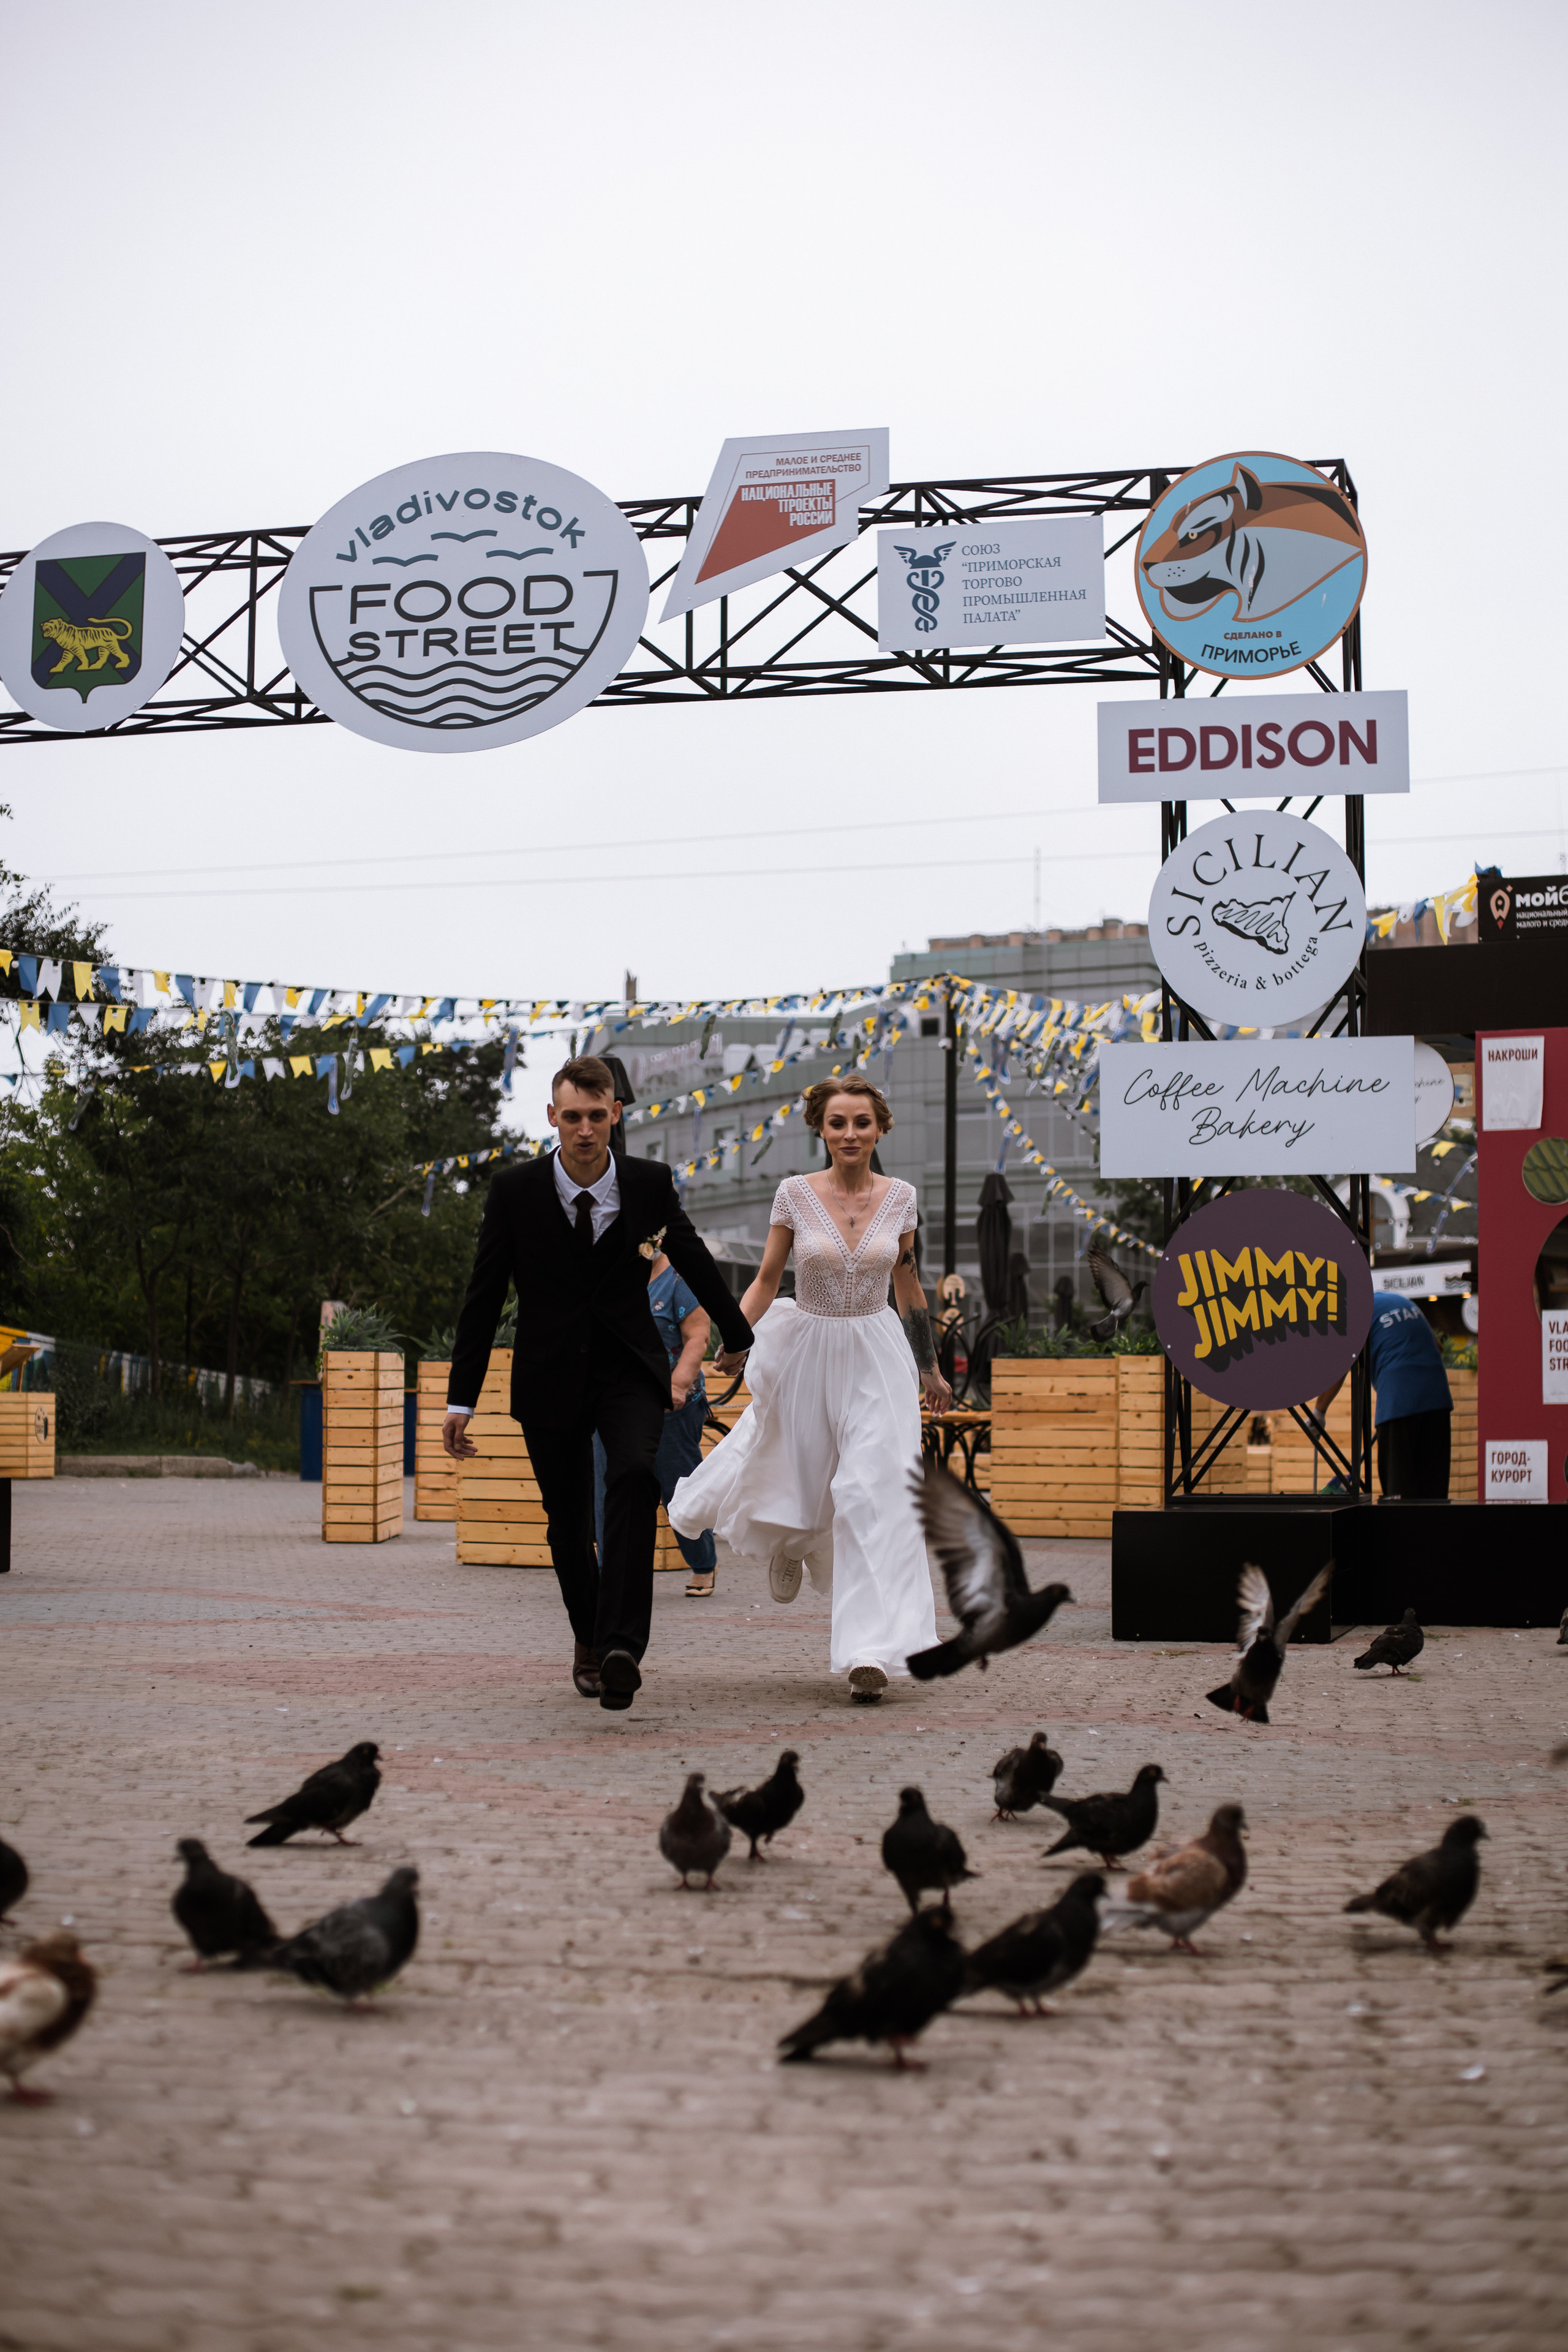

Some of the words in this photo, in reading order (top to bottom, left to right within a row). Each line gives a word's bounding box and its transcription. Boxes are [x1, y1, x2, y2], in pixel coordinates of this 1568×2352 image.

[776, 456, 809, 466] МАЛОЕ
[811, 455, 818, 464] И
[820, 453, 862, 462] СРЕДНЕЕ
[745, 463, 862, 479] ПРЕДПРИНИМАТЕЛЬСТВО
[741, 481, 833, 502] НАЦИОНАЛЬНЫЕ
[777, 496, 833, 513] ПРОЕКТЫ
[336, 488, 586, 563] vladivostok
[790, 510, 833, 527] РОССИИ
[962, 543, 1001, 556] СОЮЗ
[962, 576, 1022, 590] ТОРГОВО
[350, 575, 573, 625] FOOD
[962, 589, 1087, 606] ПРОМЫШЛЕННАЯ
[347, 621, 575, 662] STREET
[1223, 631, 1273, 641] СДЕЛАНО
[1200, 641, 1302, 663] ПРИМОРЬЕ
[1128, 719, 1378, 773] EDDISON
[1167, 833, 1353, 936] SICILIAN
[1516, 920, 1542, 929] малого
[1194, 942, 1247, 989] pizzeria
[1256, 976, 1267, 990] &
[1272, 937, 1318, 986] bottega
[1488, 1047, 1539, 1063] НАКРОШИ
[1124, 1069, 1224, 1110] Coffee
[1235, 1066, 1390, 1101] Machine
[1189, 1107, 1315, 1147] Bakery
[1178, 1246, 1338, 1306] JIMMY!
[1193, 1287, 1338, 1359] JIMMY!
[1491, 1450, 1531, 1467] ГОРОД-
[1491, 1469, 1532, 1483] КУРОРТ
